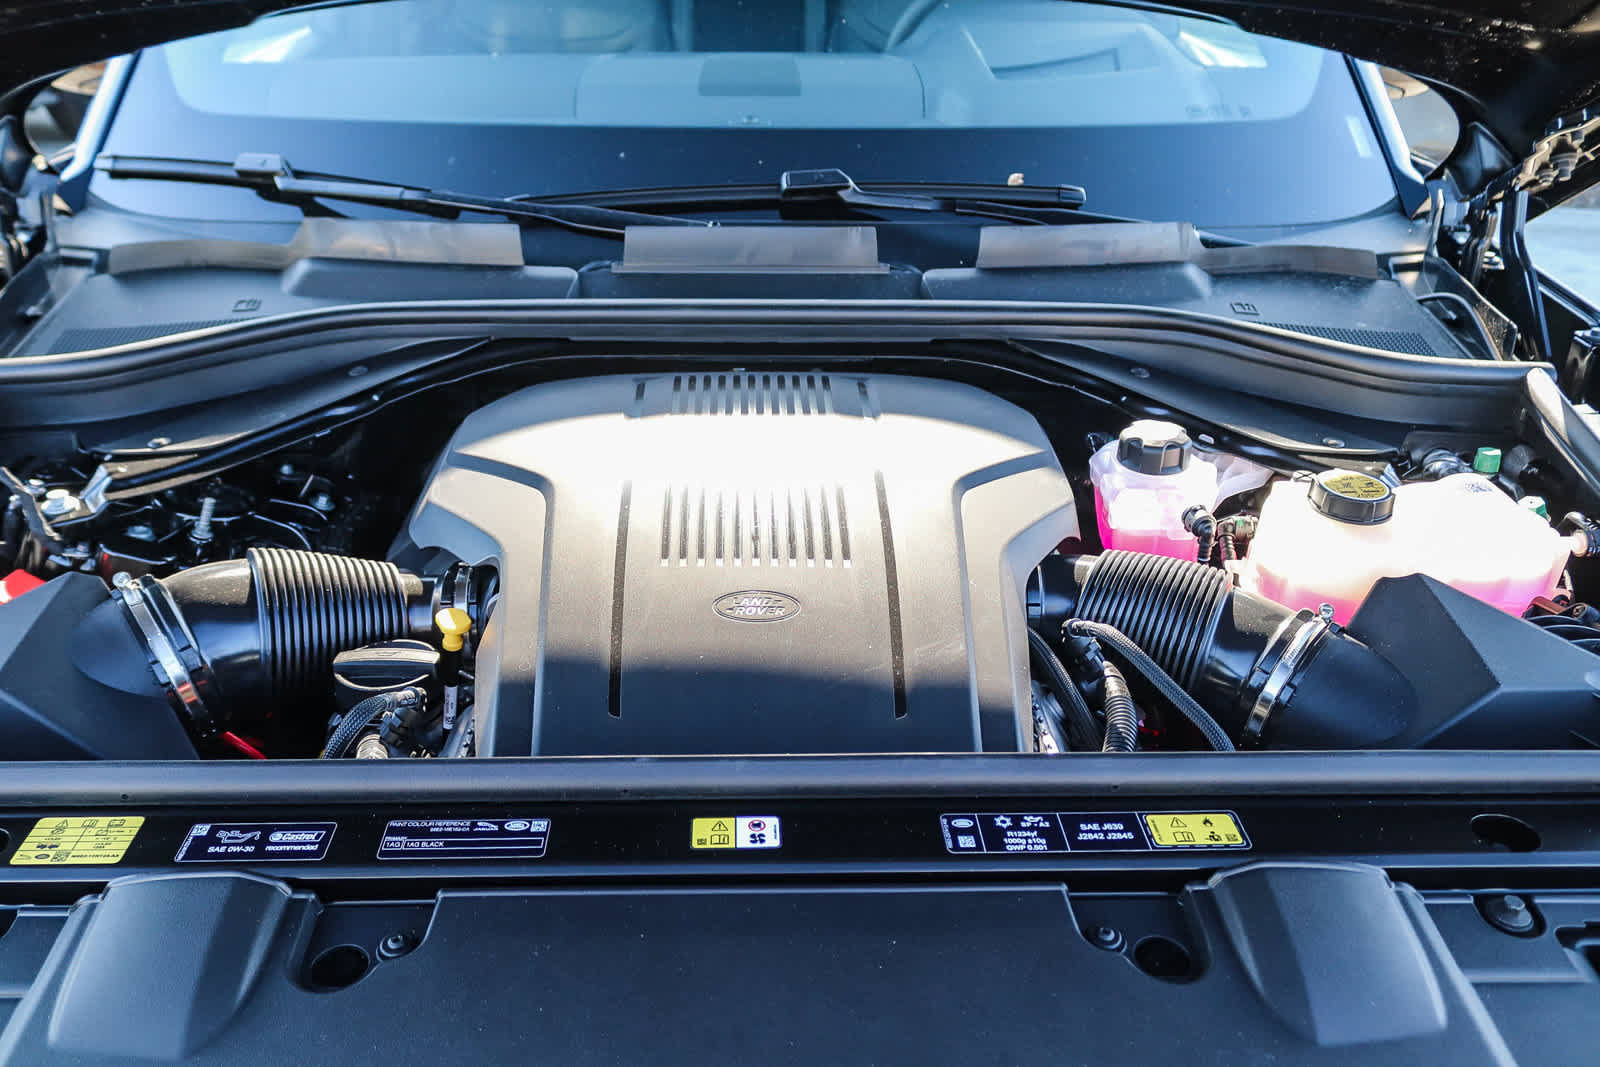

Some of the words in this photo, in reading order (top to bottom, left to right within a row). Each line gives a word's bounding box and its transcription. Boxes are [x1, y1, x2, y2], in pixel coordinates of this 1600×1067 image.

[733, 596, 773, 606] LAND
[735, 606, 786, 616] ROVER
[1079, 823, 1101, 831] SAE
[282, 831, 317, 841] Castrol
[227, 845, 256, 853] 0W-30
[265, 844, 320, 852] recommended
